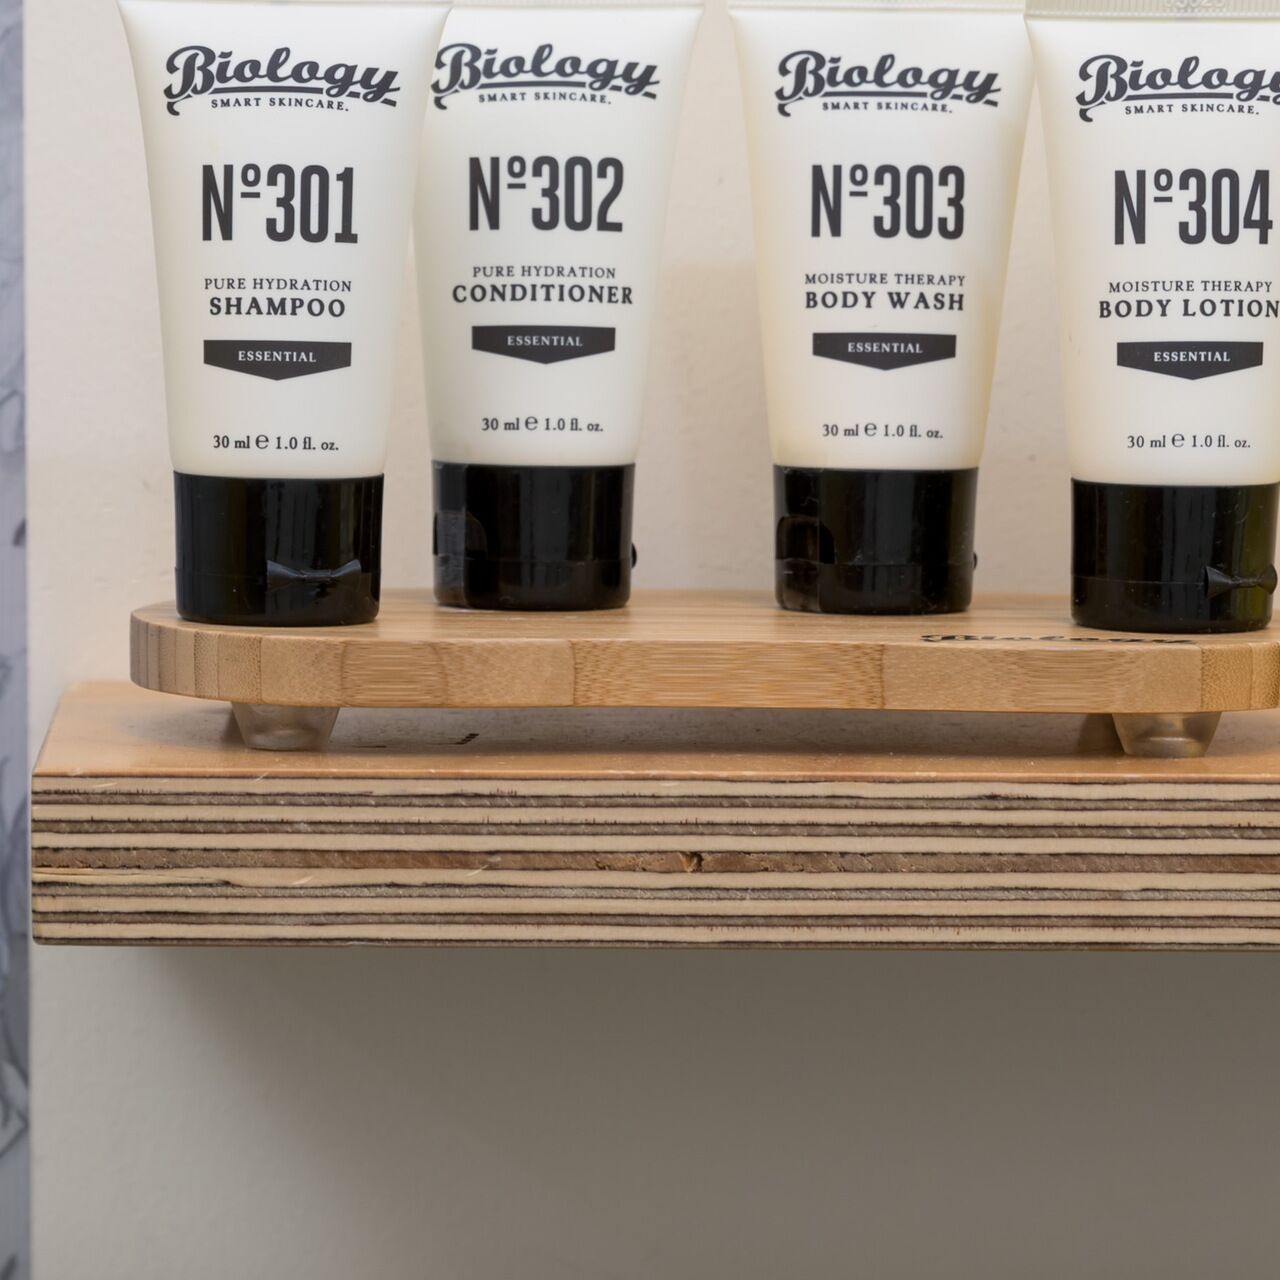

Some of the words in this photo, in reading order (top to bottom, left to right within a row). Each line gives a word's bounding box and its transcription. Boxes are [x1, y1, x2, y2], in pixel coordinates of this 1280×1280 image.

[162, 45, 401, 117] Biology
[430, 42, 661, 111] Biology
[774, 49, 1002, 118] Biology
[211, 97, 262, 109] SMART
[478, 92, 527, 103] SMART
[822, 101, 869, 111] SMART
[1124, 103, 1174, 115] SMART
[472, 265, 515, 278] PURE
[521, 265, 616, 279] HYDRATION
[804, 272, 888, 285] MOISTURE
[894, 273, 966, 287] THERAPY
[204, 277, 247, 290] PURE
[252, 278, 352, 292] HYDRATION
[1108, 280, 1195, 294] MOISTURE
[1200, 280, 1273, 293] THERAPY
[451, 283, 633, 305] CONDITIONER
[805, 290, 876, 309] BODY
[887, 291, 965, 312] WASH
[209, 296, 346, 318] SHAMPOO
[1099, 298, 1172, 319] BODY
[1182, 298, 1280, 319] LOTION
[507, 335, 583, 347] ESSENTIAL
[847, 342, 922, 354] ESSENTIAL
[238, 350, 317, 363] ESSENTIAL
[1153, 351, 1231, 362] ESSENTIAL
[481, 417, 499, 432] 30
[503, 417, 520, 431] ml
[545, 417, 566, 431] 1.0
[569, 417, 583, 432] fl.
[586, 423, 604, 432] oz.
[822, 423, 839, 437] 30
[843, 423, 859, 437] ml
[884, 424, 905, 438] 1.0
[909, 424, 922, 438] fl.
[926, 429, 944, 439] oz.
[213, 434, 230, 449] 30
[234, 435, 251, 449] ml
[276, 436, 298, 450] 1.0
[302, 436, 317, 451] fl.
[320, 441, 339, 451] oz.
[1127, 435, 1145, 449] 30
[1149, 434, 1166, 448] ml
[1192, 434, 1213, 448] 1.0
[1217, 434, 1230, 448] fl.
[1234, 439, 1251, 448] oz.
